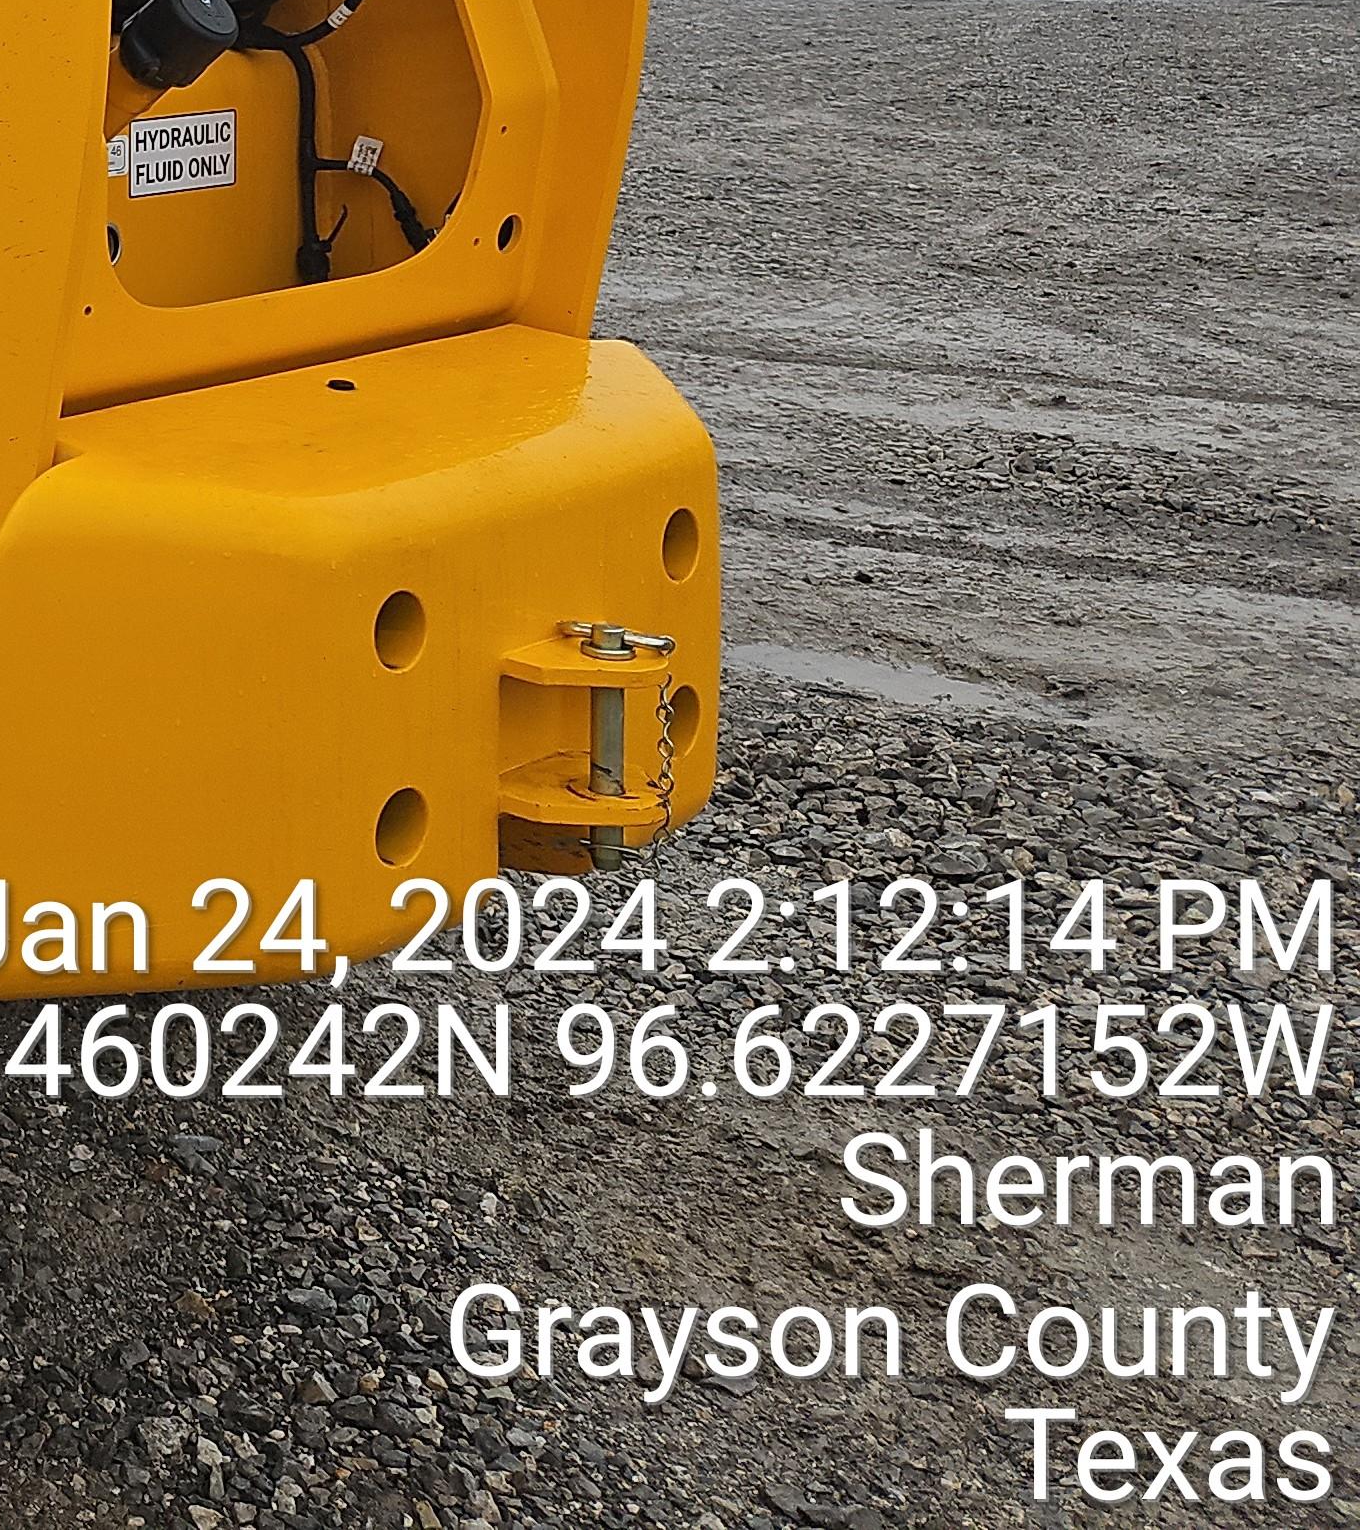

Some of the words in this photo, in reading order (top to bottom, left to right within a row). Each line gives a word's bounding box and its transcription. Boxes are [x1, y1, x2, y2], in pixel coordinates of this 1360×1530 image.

[135, 121, 231, 153] HYDRAULIC
[136, 159, 184, 185] FLUID
[188, 153, 231, 179] ONLY
